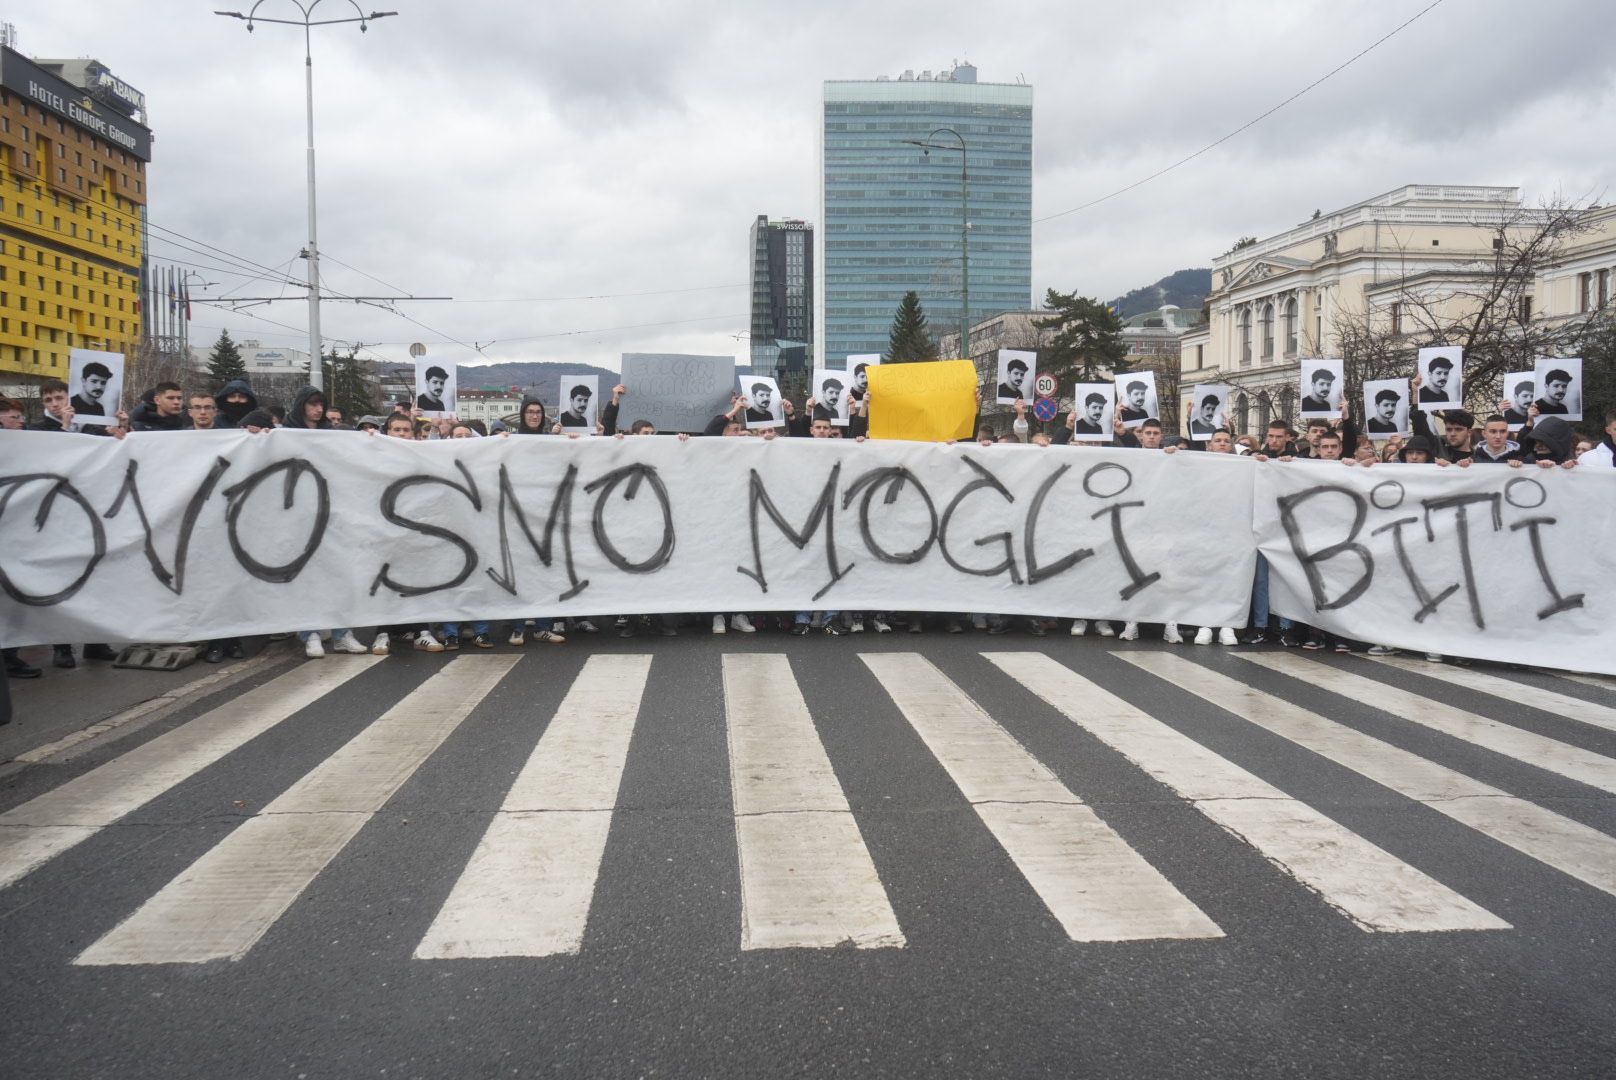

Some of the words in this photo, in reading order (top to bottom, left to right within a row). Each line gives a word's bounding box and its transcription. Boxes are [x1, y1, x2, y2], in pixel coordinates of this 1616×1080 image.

[29, 80, 66, 113] HOTEL
[68, 102, 107, 135] EUROPE
[108, 125, 137, 150] GROUP
[1038, 379, 1052, 391] 60
[0, 456, 330, 606] OVO
[370, 458, 675, 602] SMO
